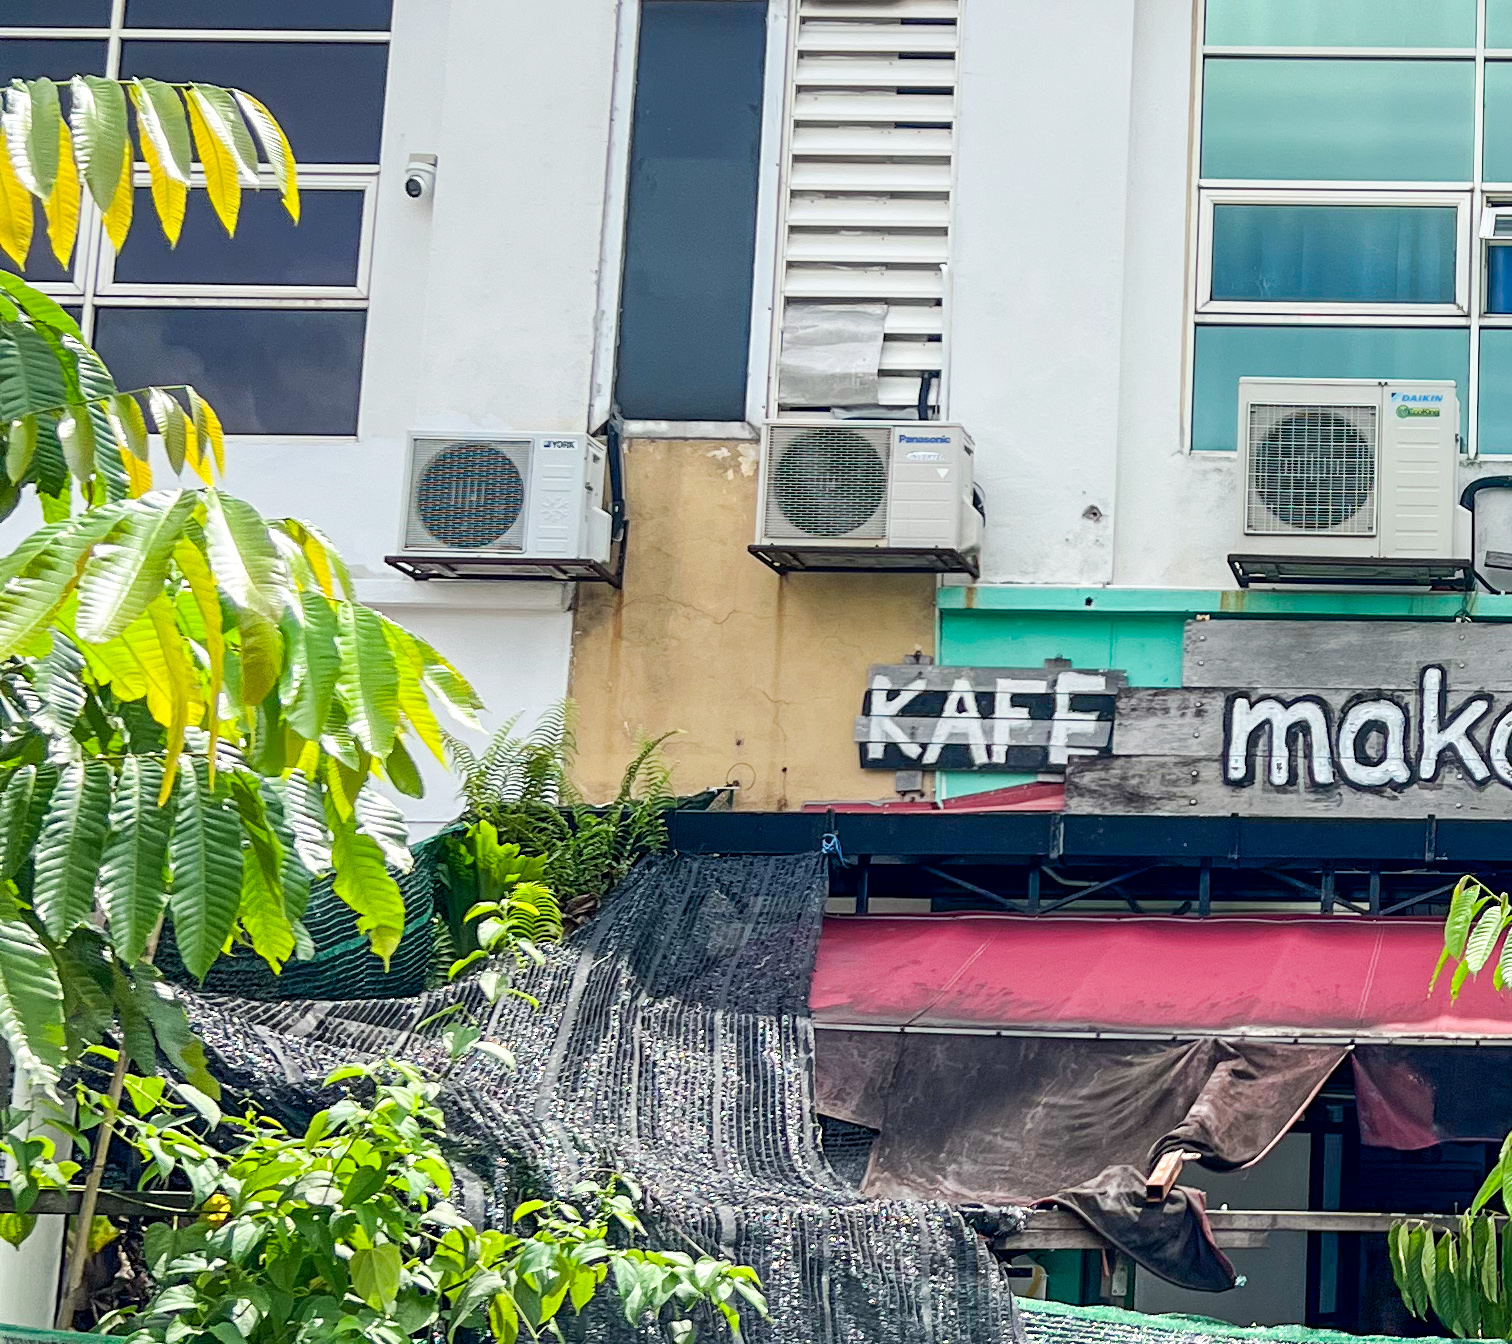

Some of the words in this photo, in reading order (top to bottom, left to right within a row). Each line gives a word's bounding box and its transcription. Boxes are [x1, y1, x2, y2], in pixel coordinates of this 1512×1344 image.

[1401, 394, 1444, 403] DAIKIN
[898, 434, 951, 444] Panasonic
[866, 671, 1107, 766] KAFE
